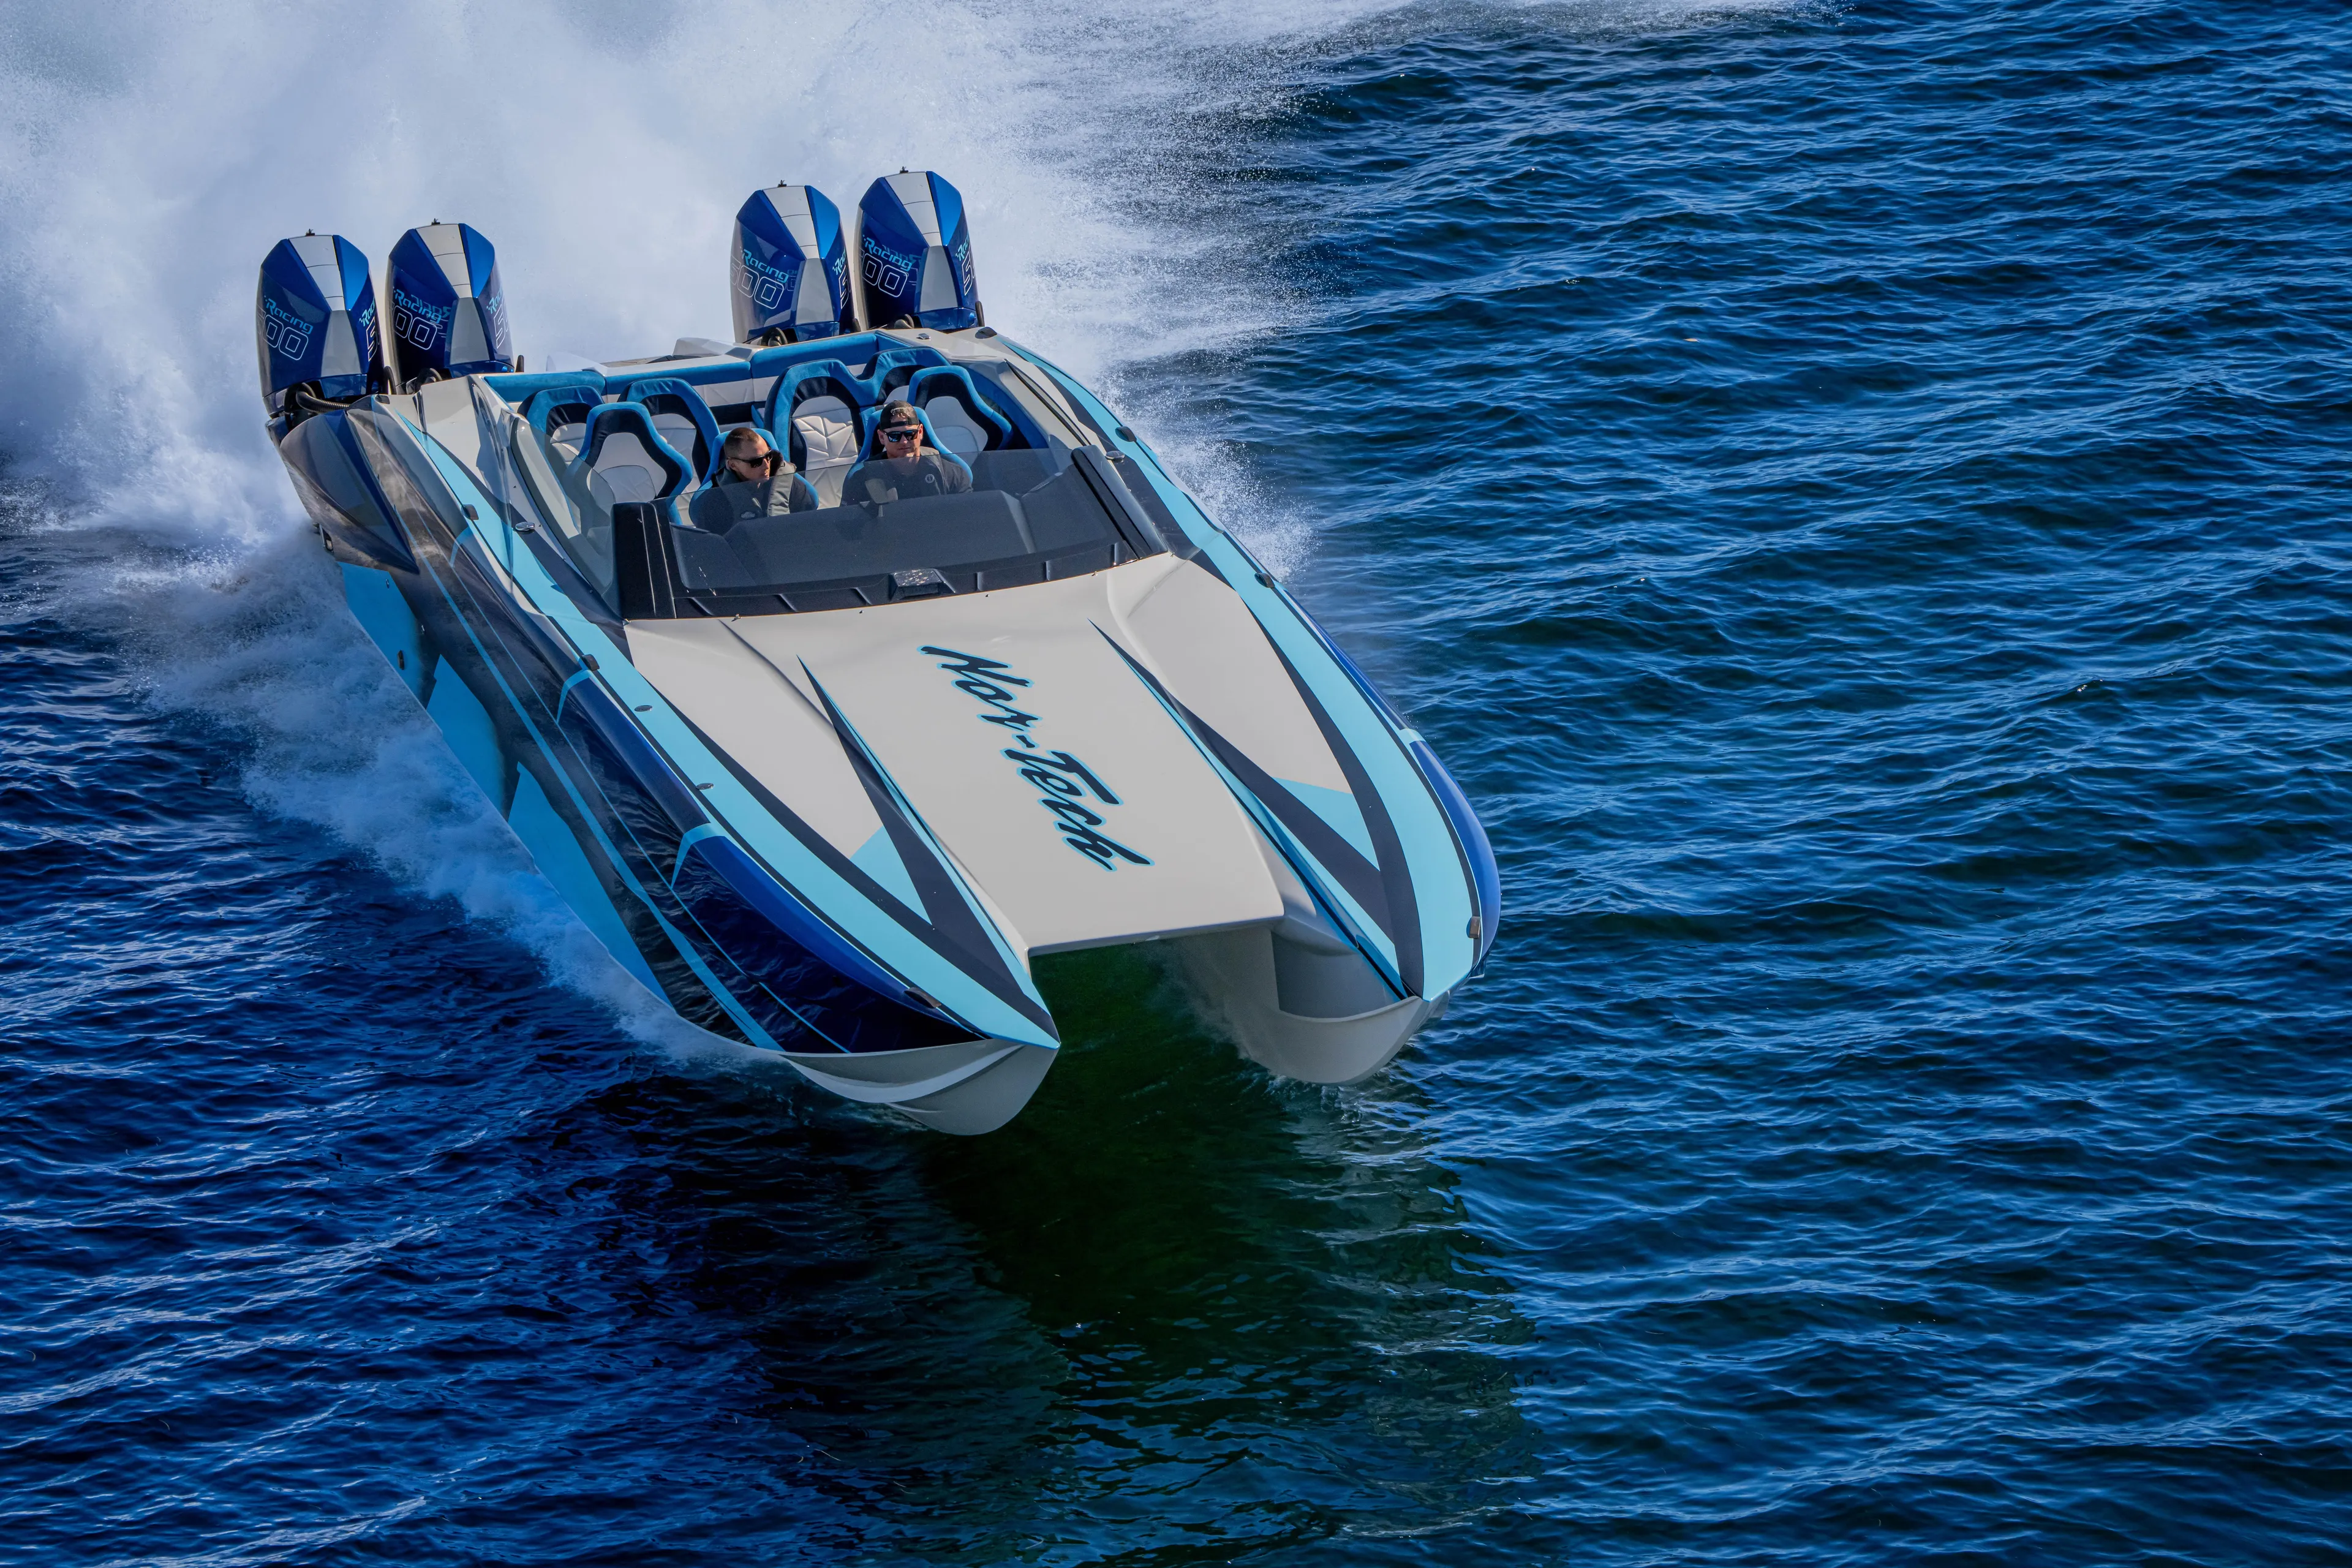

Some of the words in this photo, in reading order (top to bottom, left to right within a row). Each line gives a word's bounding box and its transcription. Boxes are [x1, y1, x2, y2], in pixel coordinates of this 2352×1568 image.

[740, 246, 789, 284] Racing
[862, 234, 912, 271] Racing
[264, 295, 313, 334] Racing
[393, 286, 442, 324] Racing
[917, 645, 1155, 872] Nor-Tech
